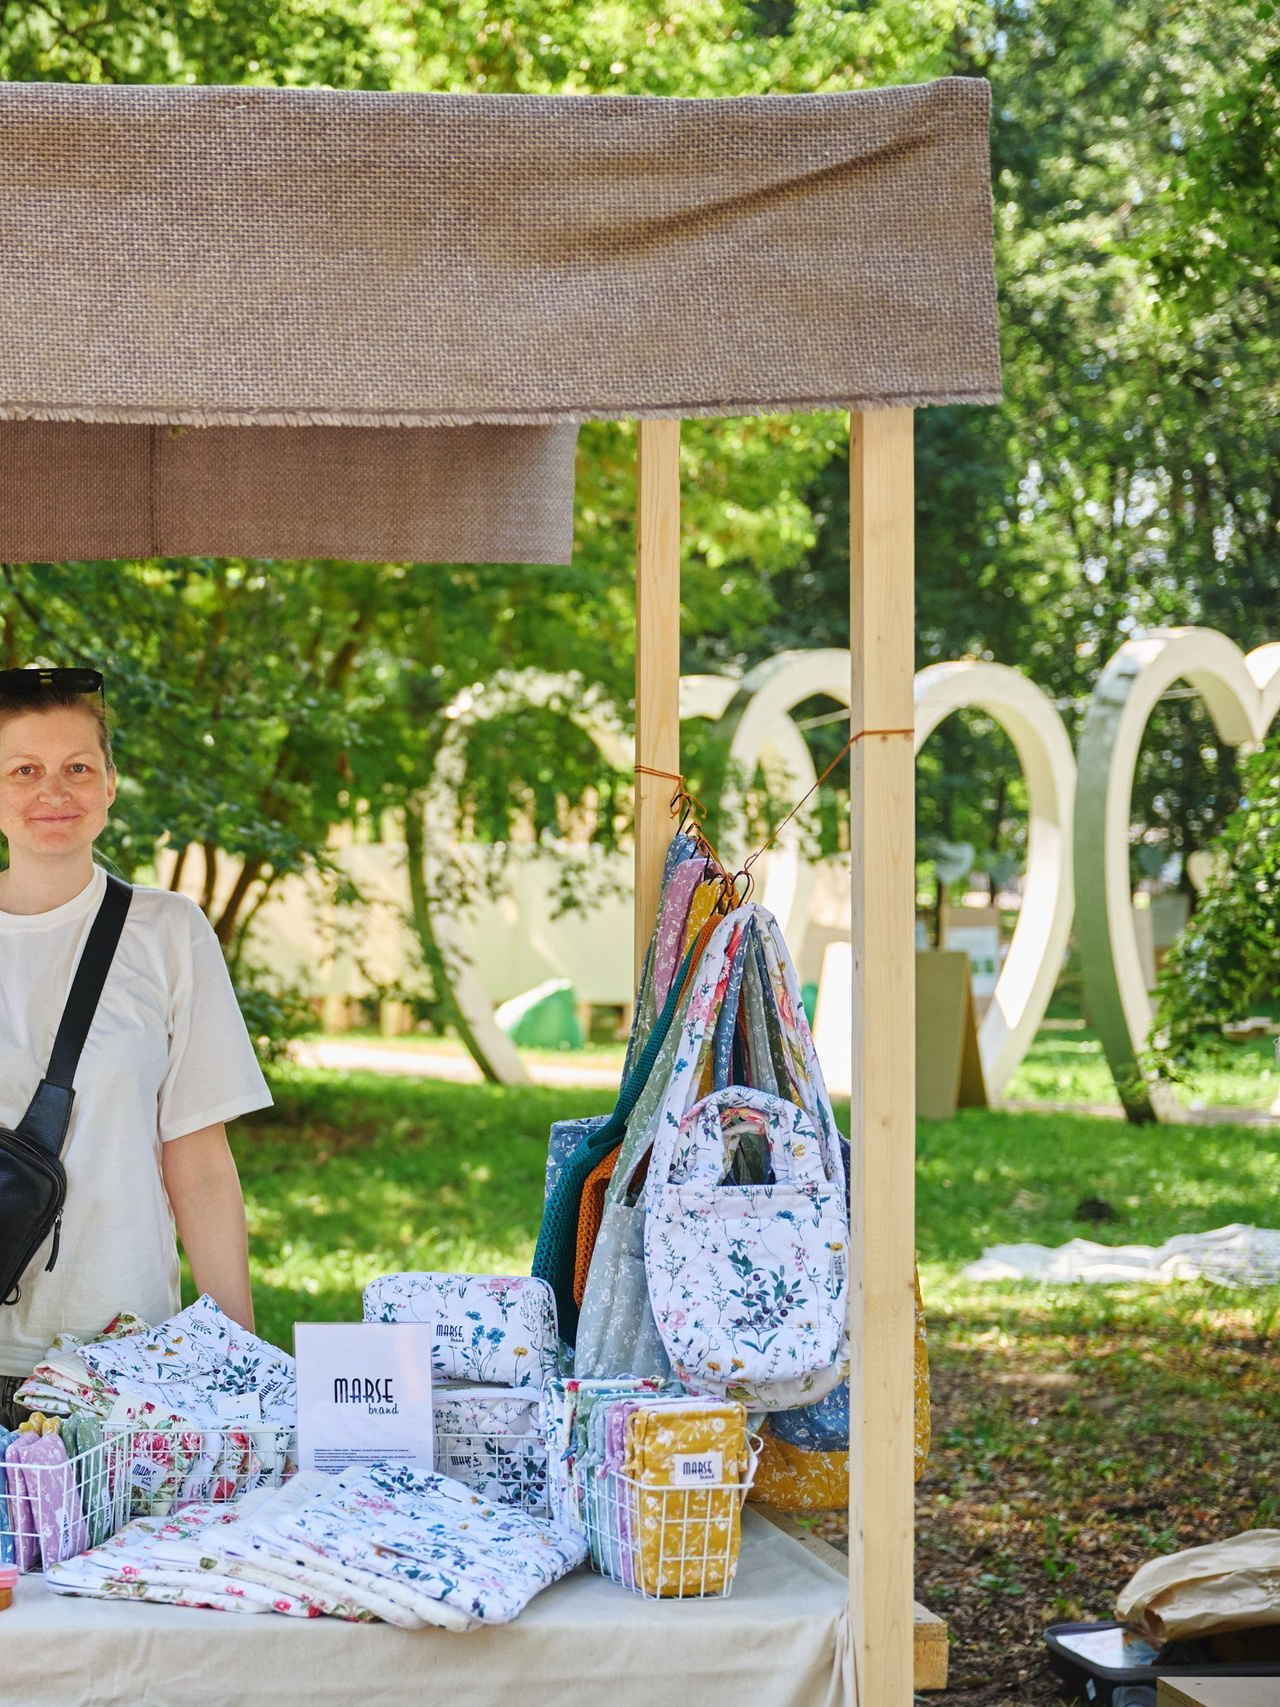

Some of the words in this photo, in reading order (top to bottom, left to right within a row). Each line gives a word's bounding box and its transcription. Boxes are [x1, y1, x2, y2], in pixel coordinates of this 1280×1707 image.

[435, 1324, 464, 1338] MARSE
[333, 1377, 394, 1404] MARSE
[367, 1402, 400, 1415] brand
[682, 1460, 713, 1475] MARSE
